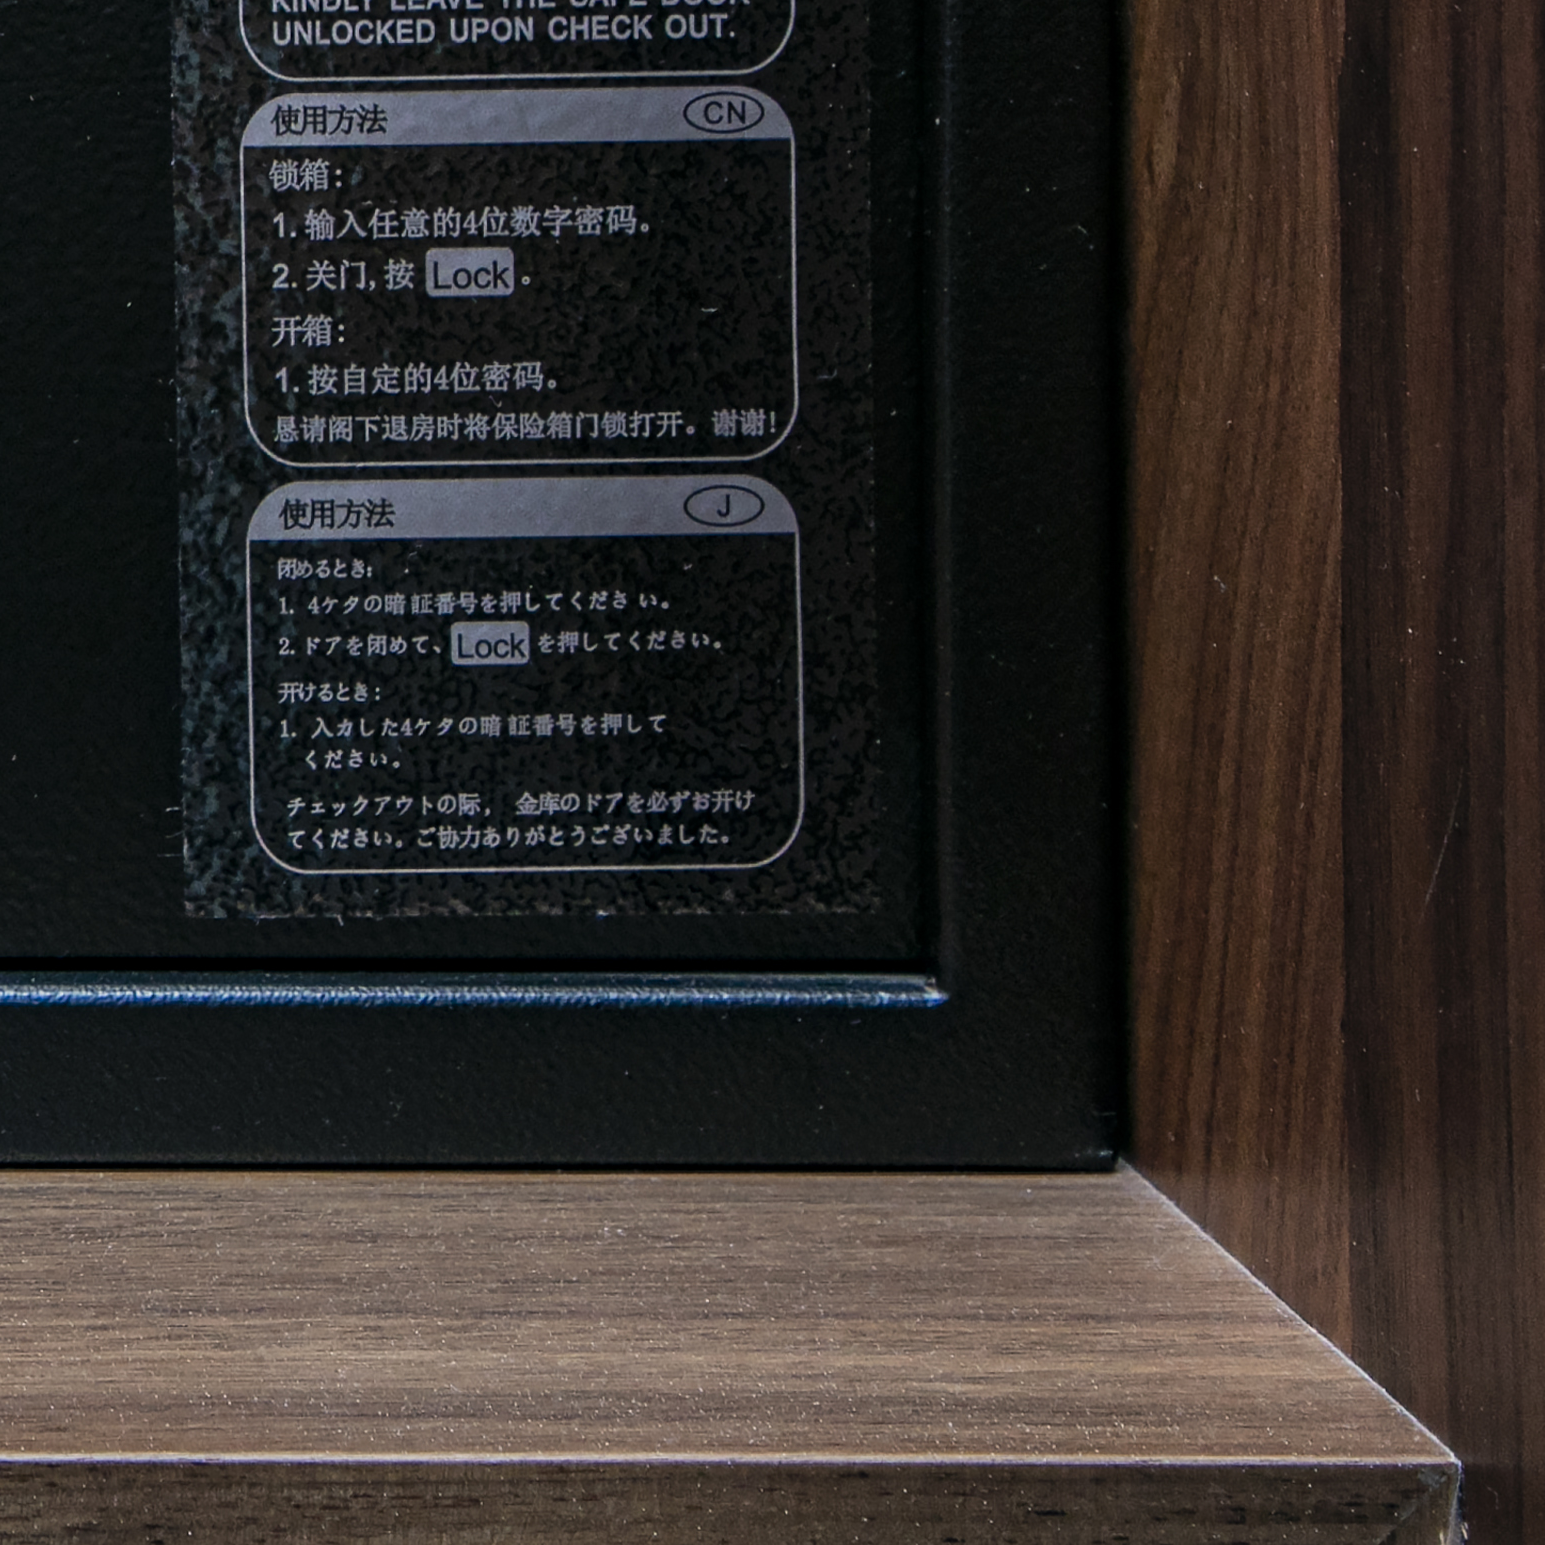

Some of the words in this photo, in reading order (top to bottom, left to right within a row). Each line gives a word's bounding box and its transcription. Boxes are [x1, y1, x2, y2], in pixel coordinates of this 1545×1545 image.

[272, 19, 436, 45] UNLOCKED
[450, 18, 533, 43] UPON
[548, 15, 652, 41] CHECK
[665, 13, 735, 39] OUT.
[270, 104, 388, 136] 使用方法
[704, 101, 745, 124] CN
[272, 212, 297, 238] 1.
[305, 205, 649, 241] 输入任意的4位数字密码。
[272, 263, 297, 289] 2.
[433, 260, 510, 290] Lock
[275, 366, 299, 393] 1.
[308, 361, 557, 395] 按自定的4位密码。
[279, 498, 396, 530] 使用方法
[716, 494, 730, 517] J
[458, 633, 526, 660] Lock
[305, 749, 401, 770] ください。
